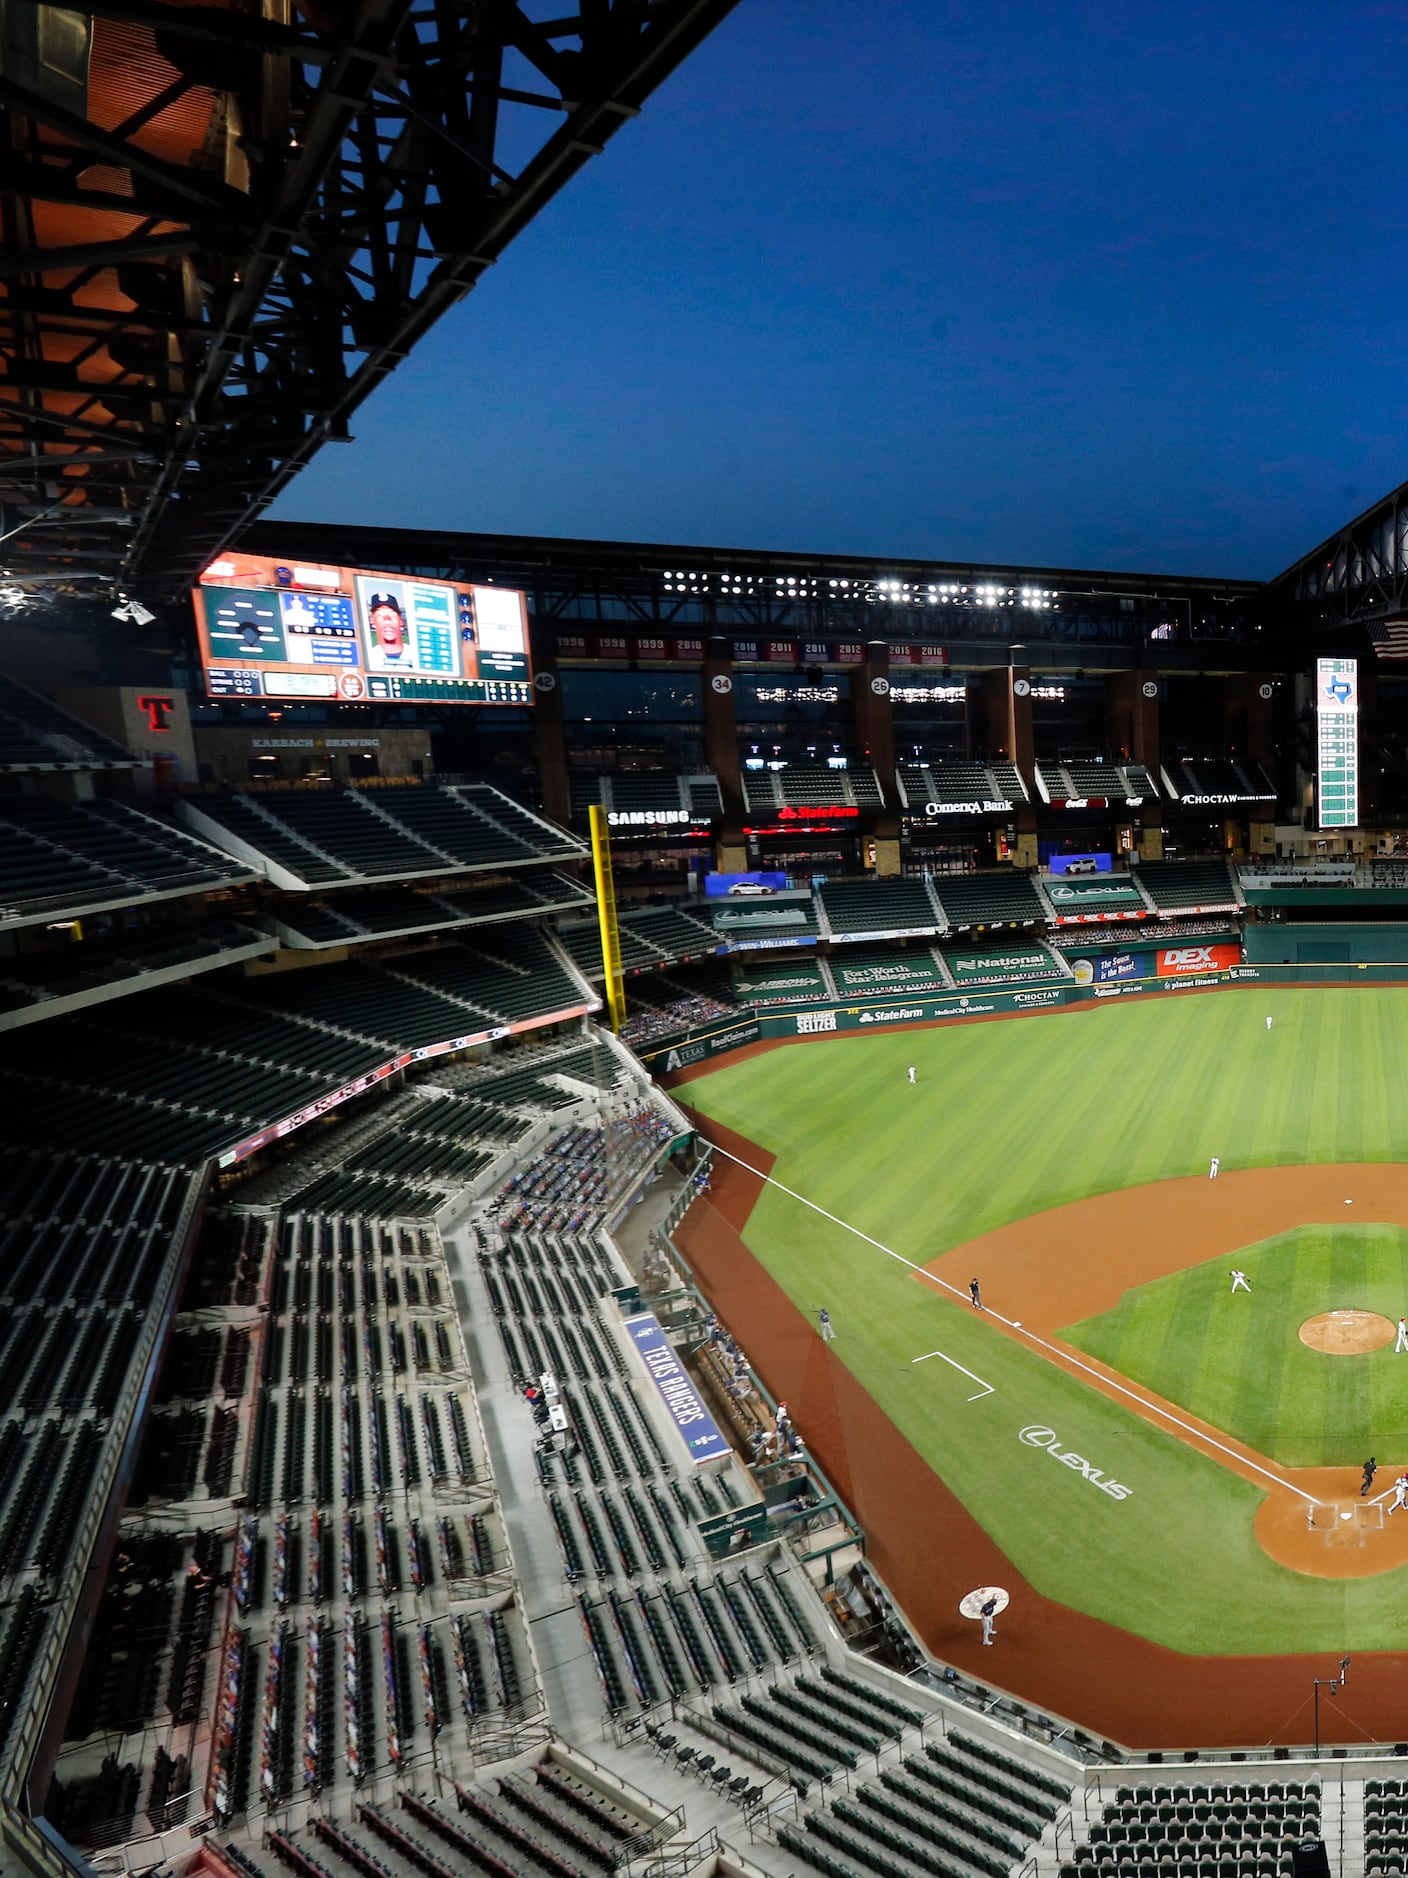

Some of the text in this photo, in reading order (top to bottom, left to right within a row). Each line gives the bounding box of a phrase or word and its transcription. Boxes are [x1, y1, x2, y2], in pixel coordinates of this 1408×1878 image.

[557, 637, 585, 647] 1996
[599, 638, 626, 648] 1998
[638, 639, 664, 648] 1999
[677, 640, 702, 650] 2010
[733, 642, 757, 651] 2010
[770, 642, 792, 652] 2011
[805, 644, 826, 653] 2011
[839, 645, 862, 654] 2012
[889, 646, 910, 655] 2015
[921, 646, 942, 656] 2016
[536, 676, 552, 687] 42
[714, 679, 730, 689] 34
[873, 682, 887, 691] 26
[1019, 684, 1025, 692] 7
[1144, 686, 1155, 694] 29
[1262, 687, 1270, 695] 10
[138, 696, 174, 731] T
[252, 738, 379, 748] KARBACH BREWING
[1188, 794, 1237, 804] CHOCTAW
[983, 800, 1013, 812] Bank
[608, 810, 690, 825] SAMSUNG
[1076, 886, 1133, 896] LEXUS
[1159, 904, 1239, 916] WHATABURGER WHATABURGER
[978, 954, 1047, 968] National
[1163, 946, 1215, 966] DEX
[1101, 955, 1130, 969] The Sauce
[842, 965, 910, 980] Fort Worth
[1101, 962, 1136, 980] is the Boss!
[754, 977, 804, 990] ARROW
[1171, 977, 1218, 990] planet fitness
[1018, 991, 1059, 1002] CHOCTAW
[966, 1004, 994, 1013] Healthcare
[797, 1012, 835, 1020] BUD LIGHT
[797, 1018, 837, 1034] SELTZER
[710, 1027, 758, 1048] RoofClaim.com
[680, 1046, 704, 1059] TEXAS
[643, 1345, 705, 1426] TEXAS RANGERS
[1046, 1442, 1133, 1500] LEXUS
